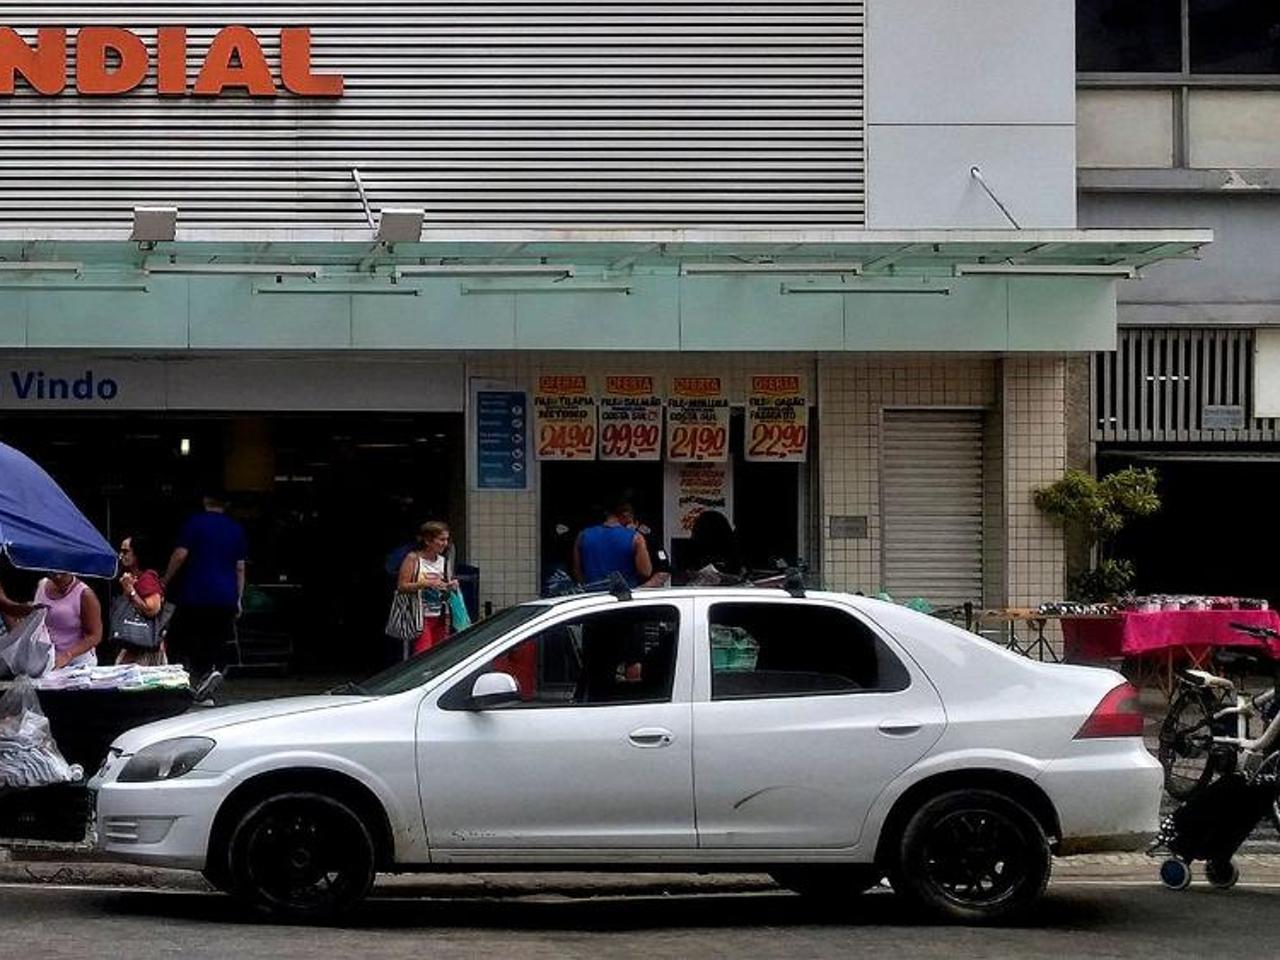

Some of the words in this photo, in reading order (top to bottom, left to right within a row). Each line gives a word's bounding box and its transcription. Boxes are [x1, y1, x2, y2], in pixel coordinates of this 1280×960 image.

[10, 370, 118, 399] Vindo
[541, 377, 584, 388] OFERTA
[608, 377, 651, 389] OFERTA
[754, 377, 798, 390] OFERTA
